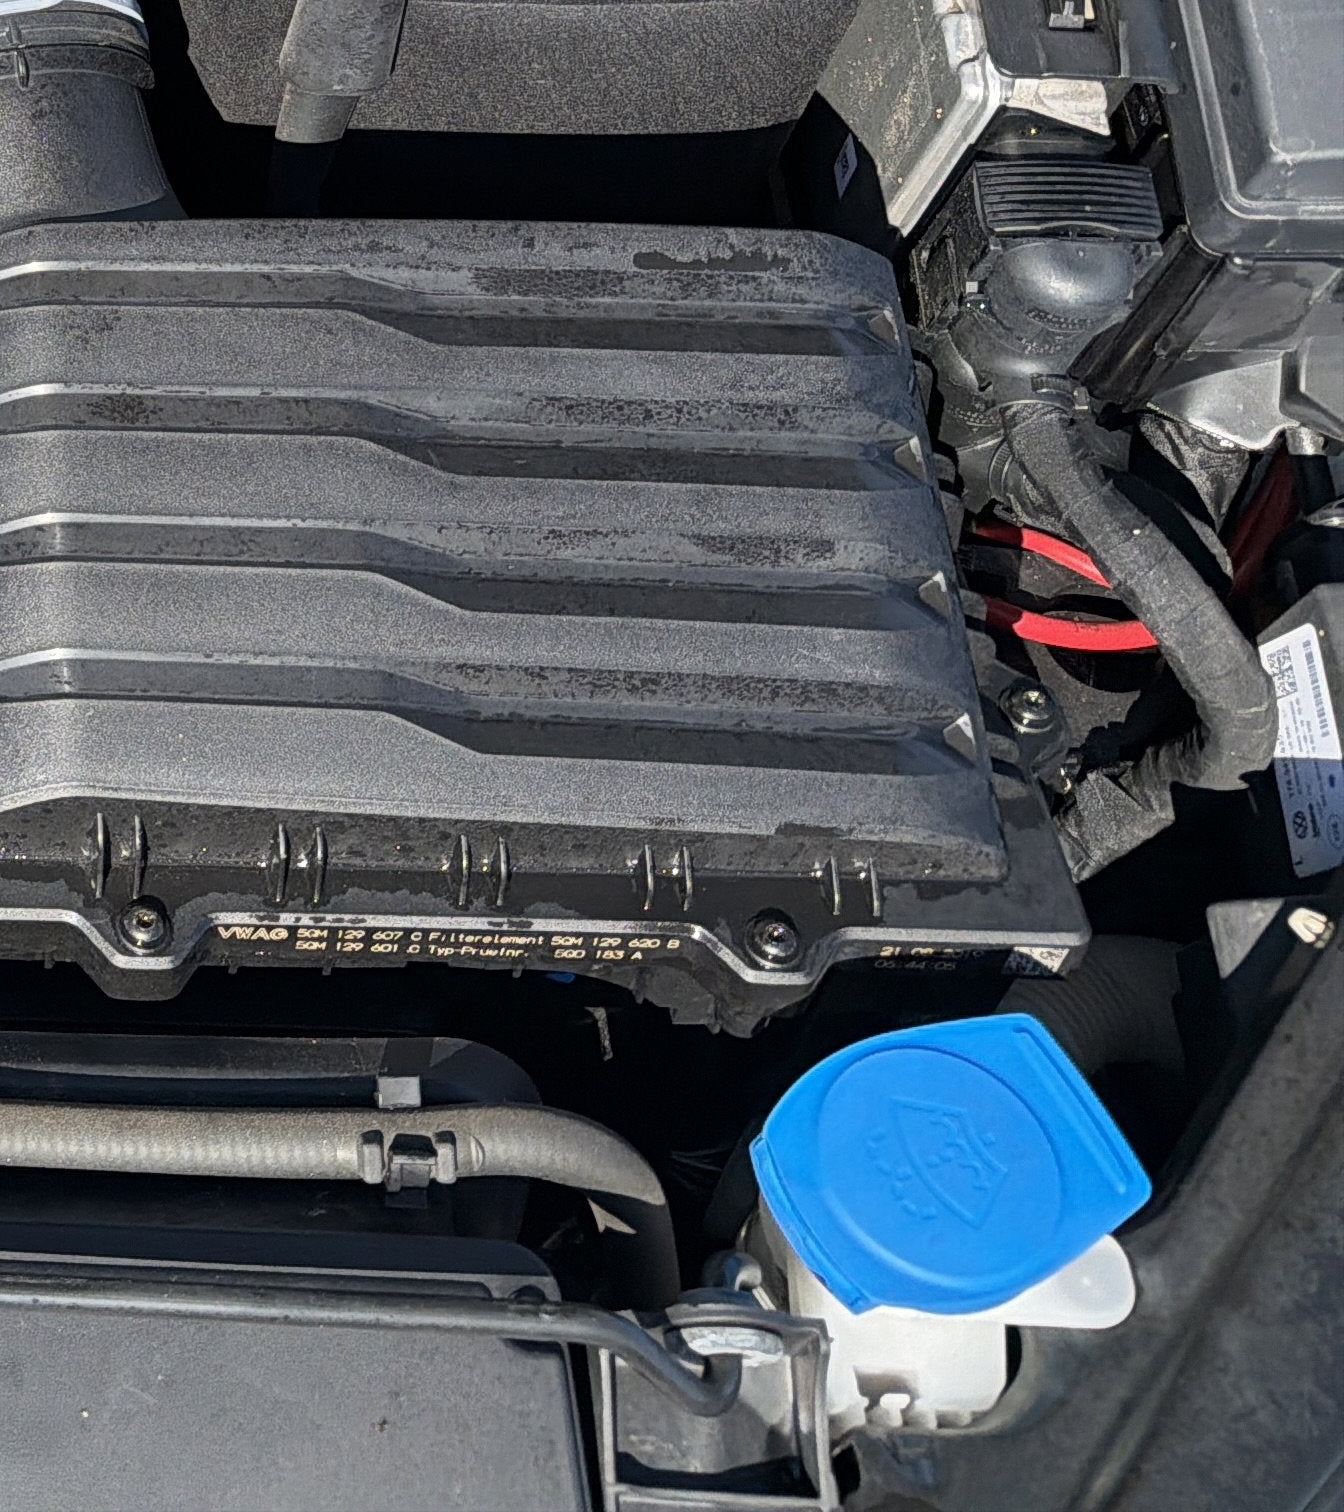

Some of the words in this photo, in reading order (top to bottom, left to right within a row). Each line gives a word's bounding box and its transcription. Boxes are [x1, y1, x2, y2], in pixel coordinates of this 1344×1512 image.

[337, 929, 365, 940] 129
[371, 930, 403, 941] 607
[410, 931, 422, 941] C
[428, 930, 544, 946] Filterelement
[591, 936, 622, 947] 129
[627, 937, 661, 948] 620
[666, 938, 681, 949] B
[335, 941, 364, 952] 129
[370, 943, 399, 953] 601
[594, 949, 625, 960] 183
[630, 950, 644, 961] A
